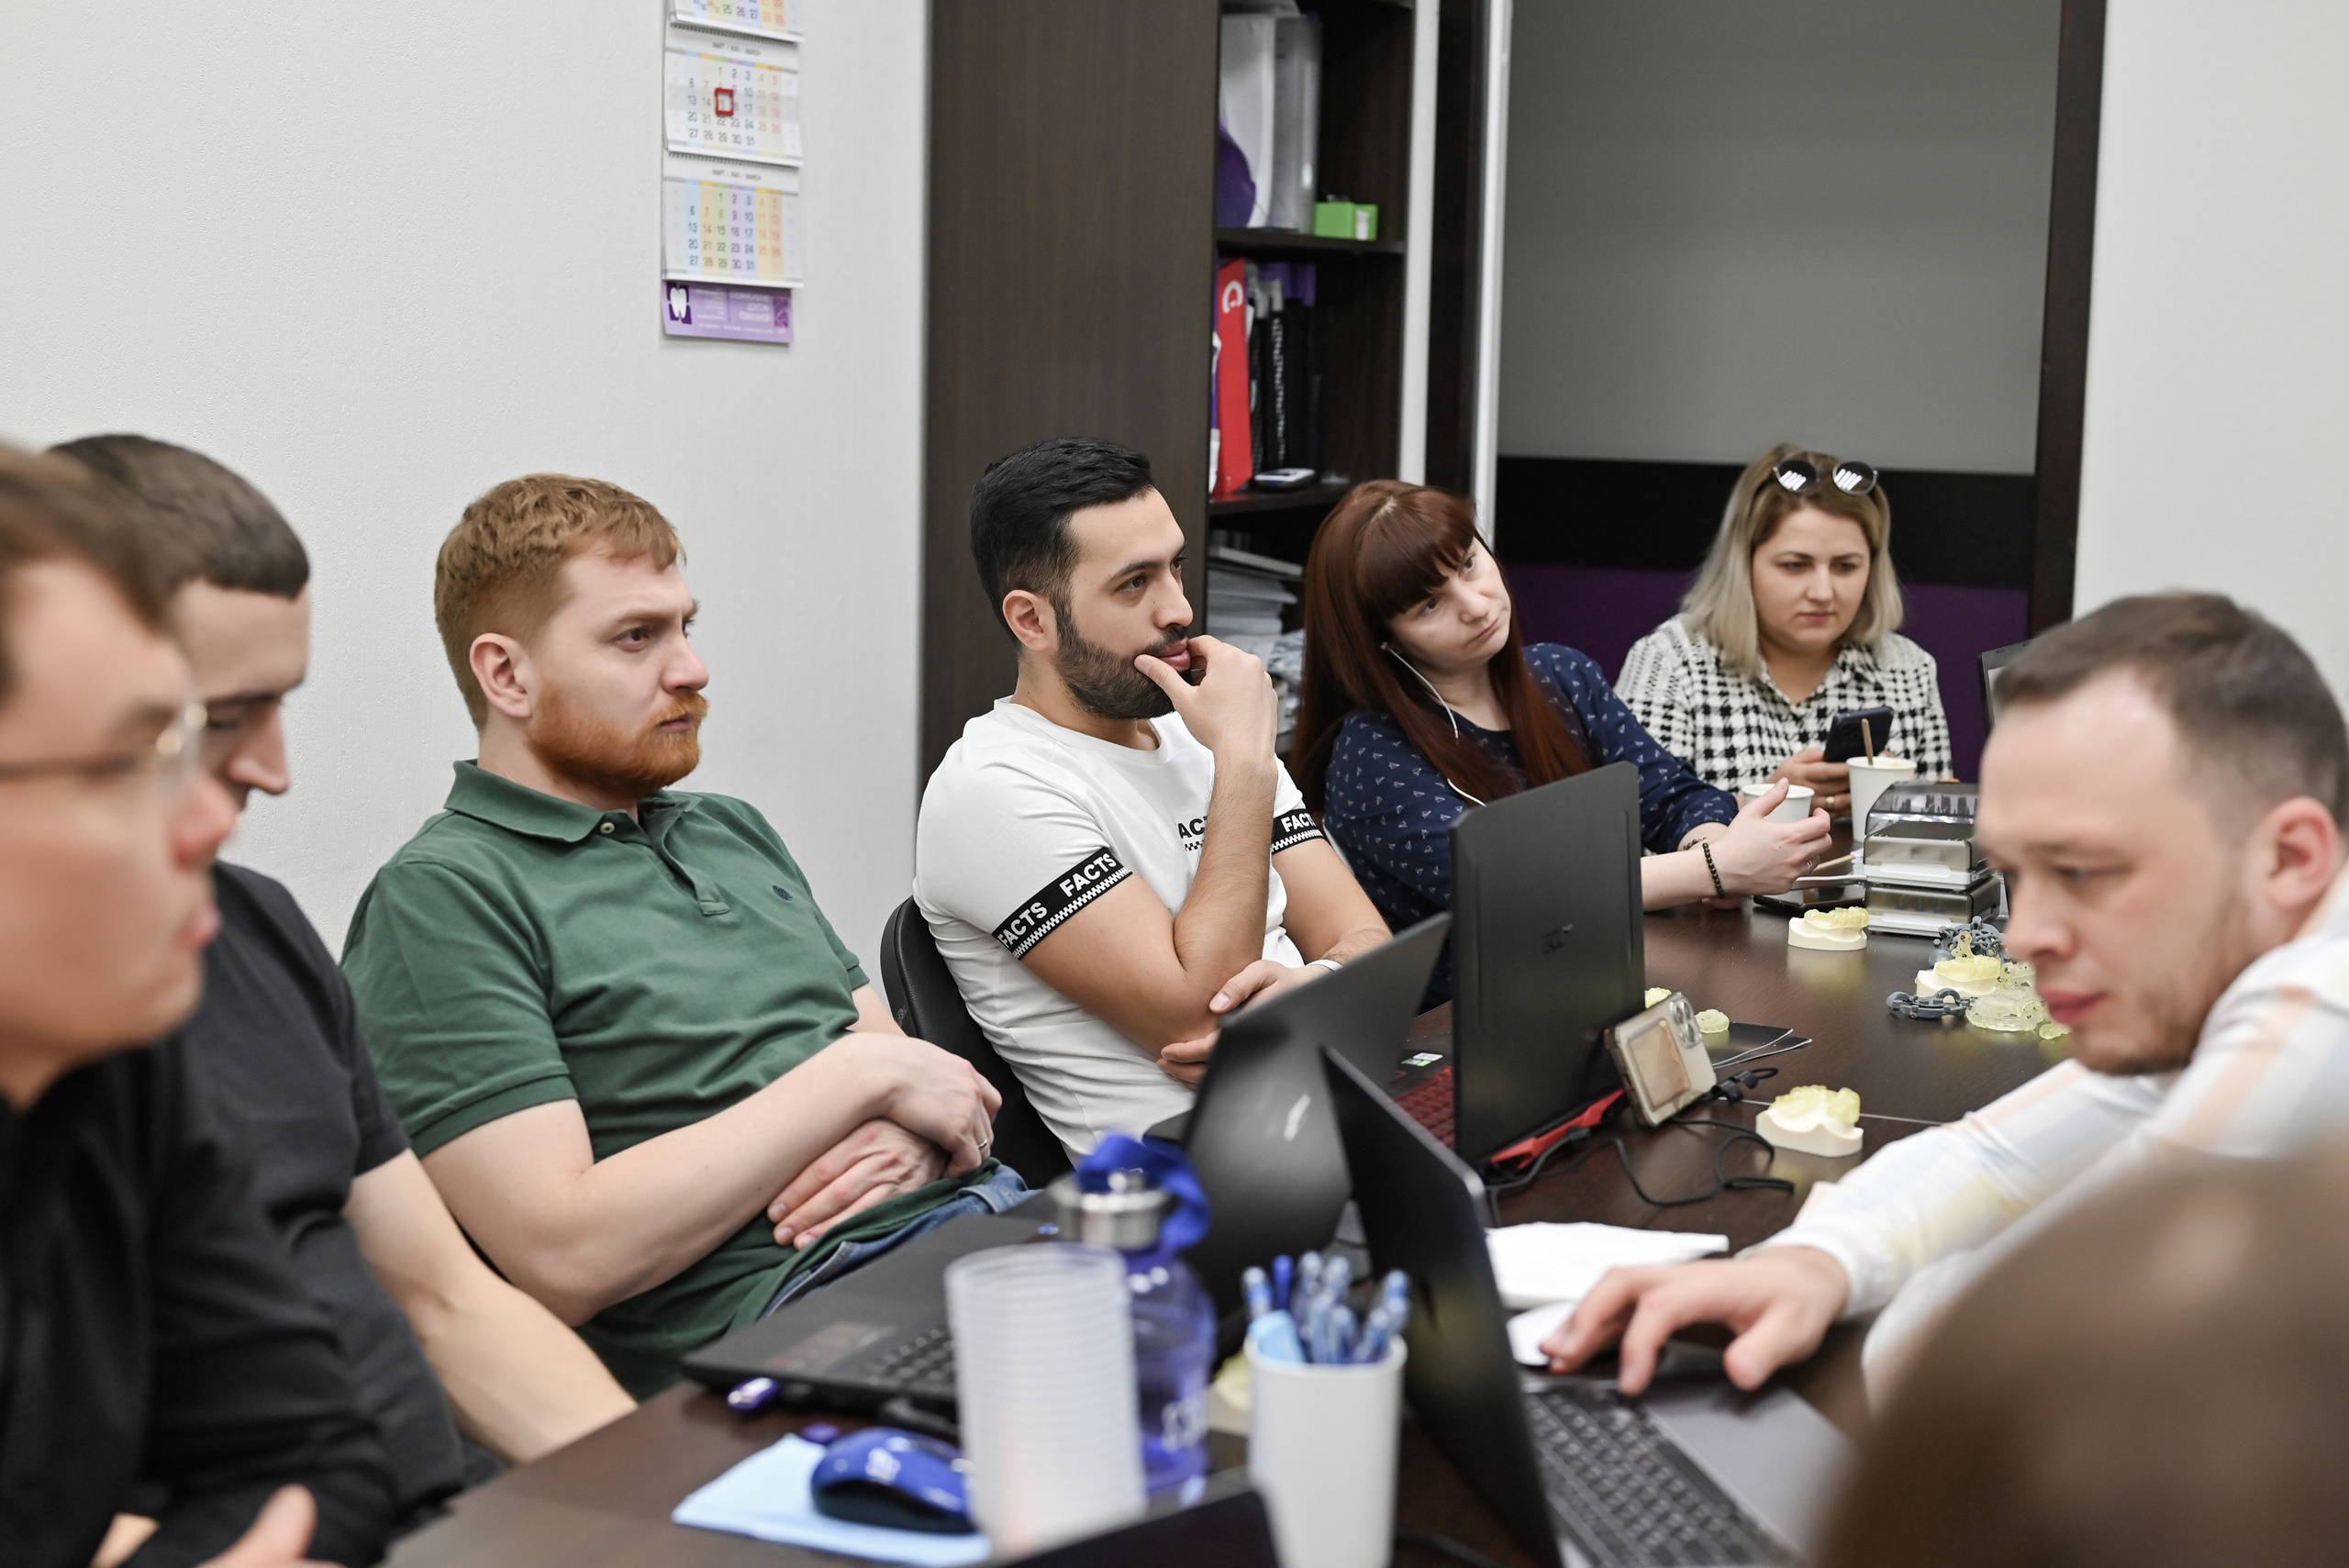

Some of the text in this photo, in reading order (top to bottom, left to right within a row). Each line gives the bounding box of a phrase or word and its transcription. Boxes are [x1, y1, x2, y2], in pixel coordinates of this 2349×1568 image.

[750, 9, 758, 19] 27
[1178, 815, 1208, 839] AC
[1280, 812, 1316, 833] FACT
[997, 853, 1117, 948] FACTS FACTS
